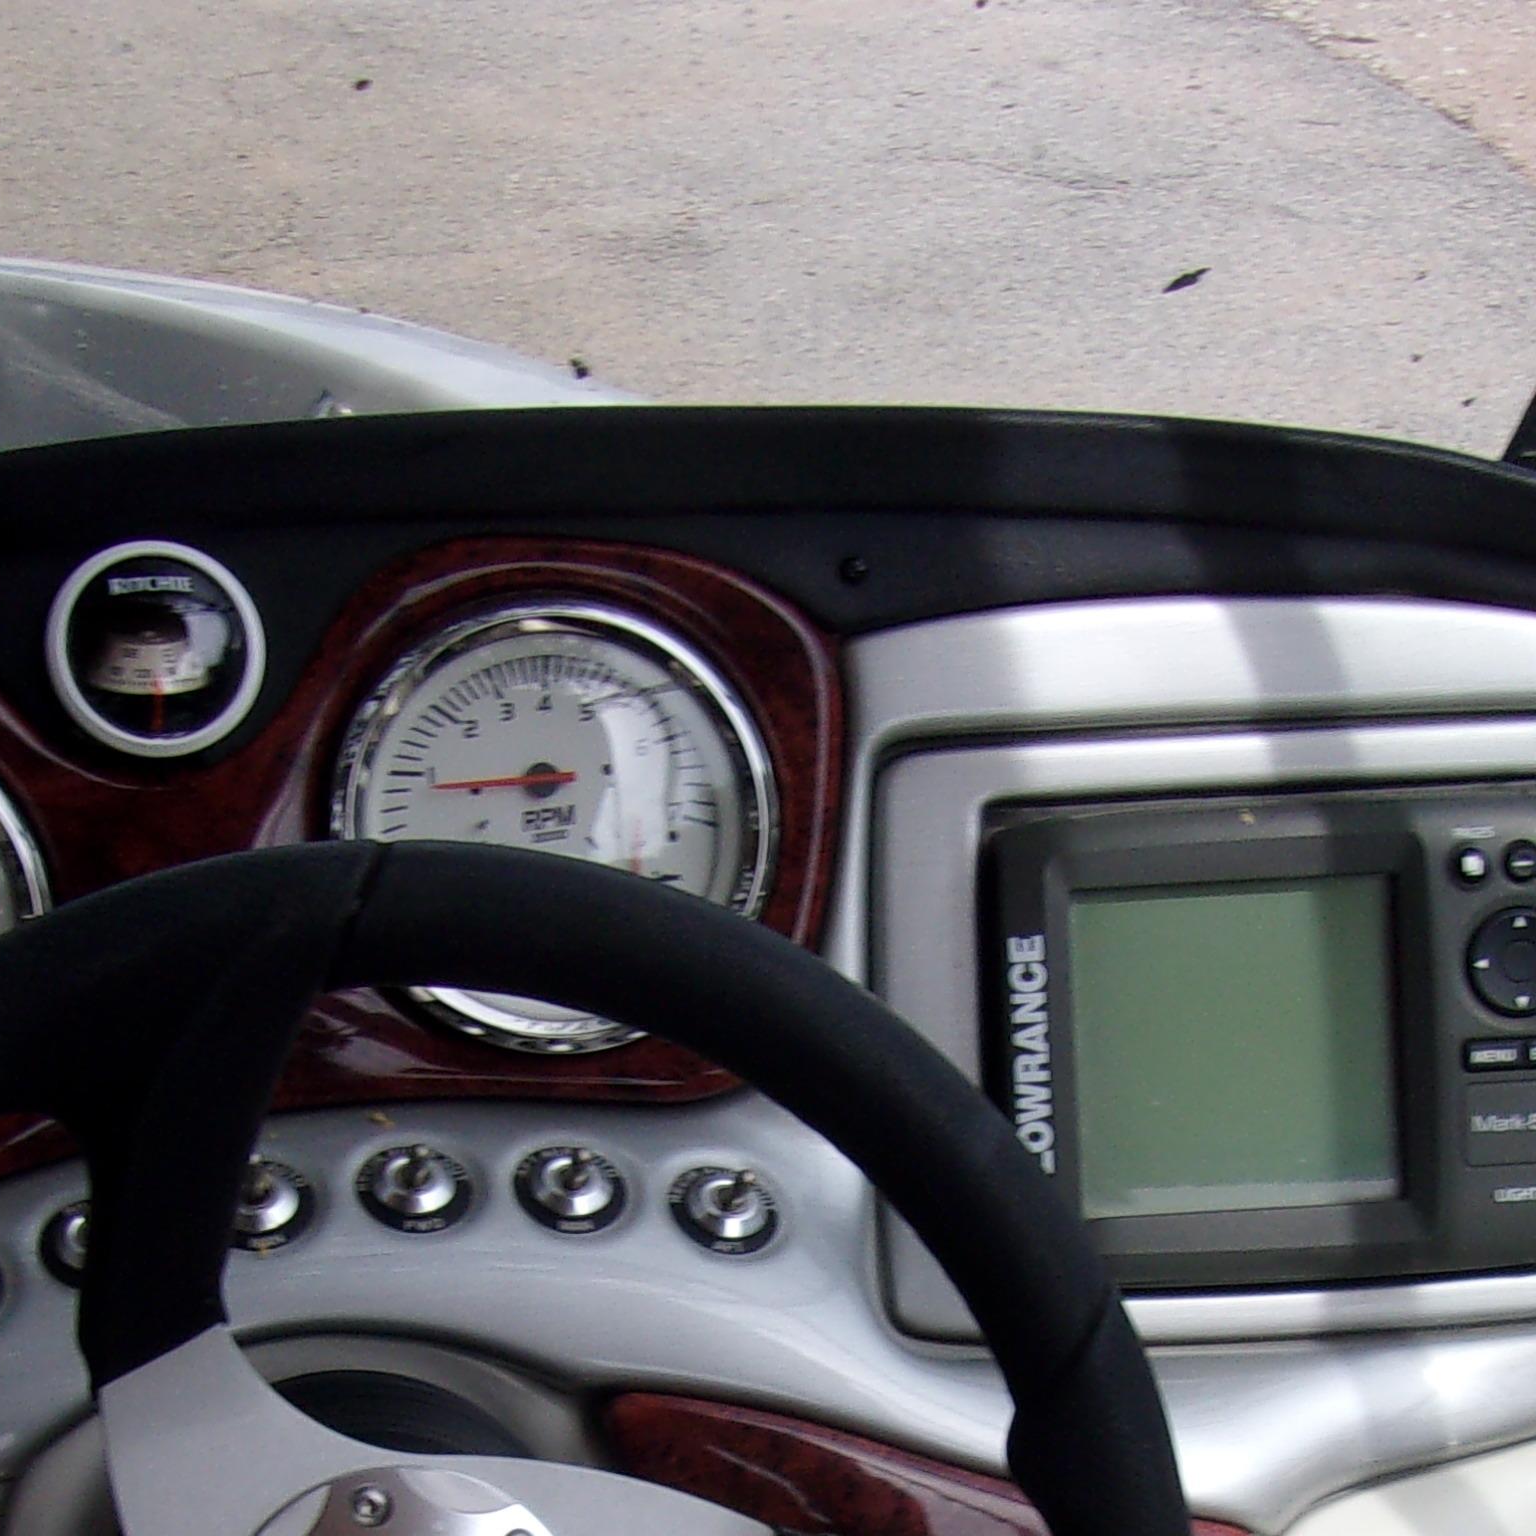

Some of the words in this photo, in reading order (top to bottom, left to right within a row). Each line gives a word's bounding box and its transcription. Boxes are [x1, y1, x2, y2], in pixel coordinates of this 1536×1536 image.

[499, 702, 515, 722] 3
[580, 703, 596, 722] 5
[463, 719, 480, 739] 2
[521, 803, 577, 832] RPM
